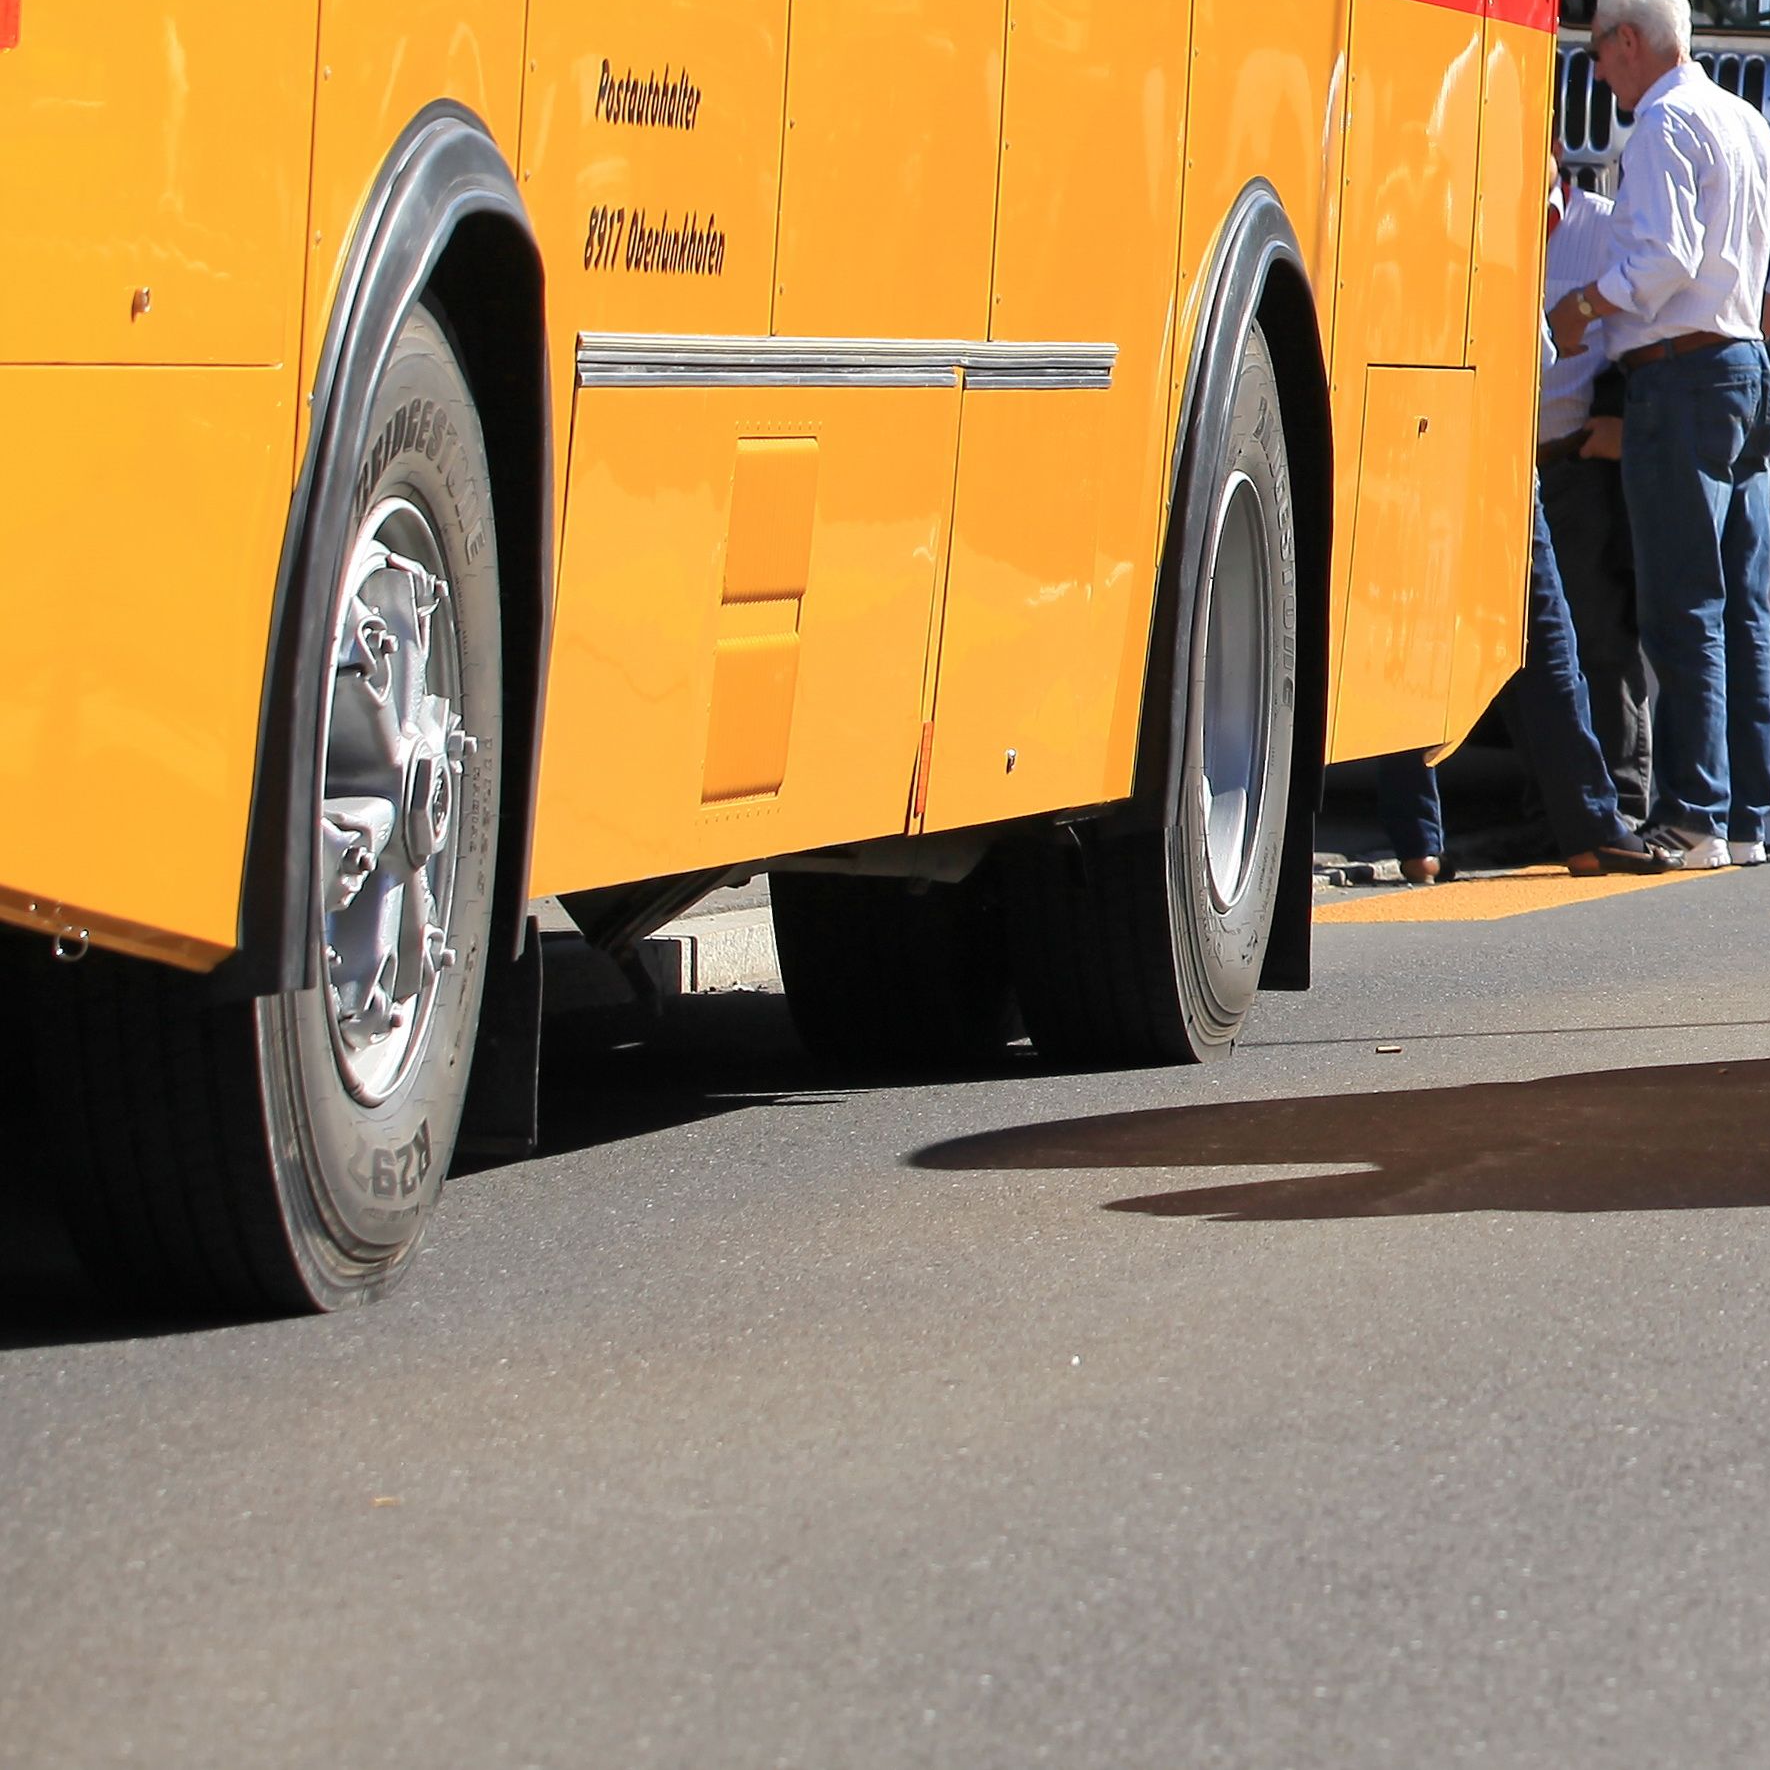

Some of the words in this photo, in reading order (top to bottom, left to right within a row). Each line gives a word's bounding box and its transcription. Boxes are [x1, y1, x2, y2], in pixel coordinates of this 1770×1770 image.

[596, 58, 701, 131] Postautohalter
[584, 204, 625, 272] 8917
[626, 207, 725, 276] Oberlunkhofen
[354, 397, 487, 566] BRIDGESTONE
